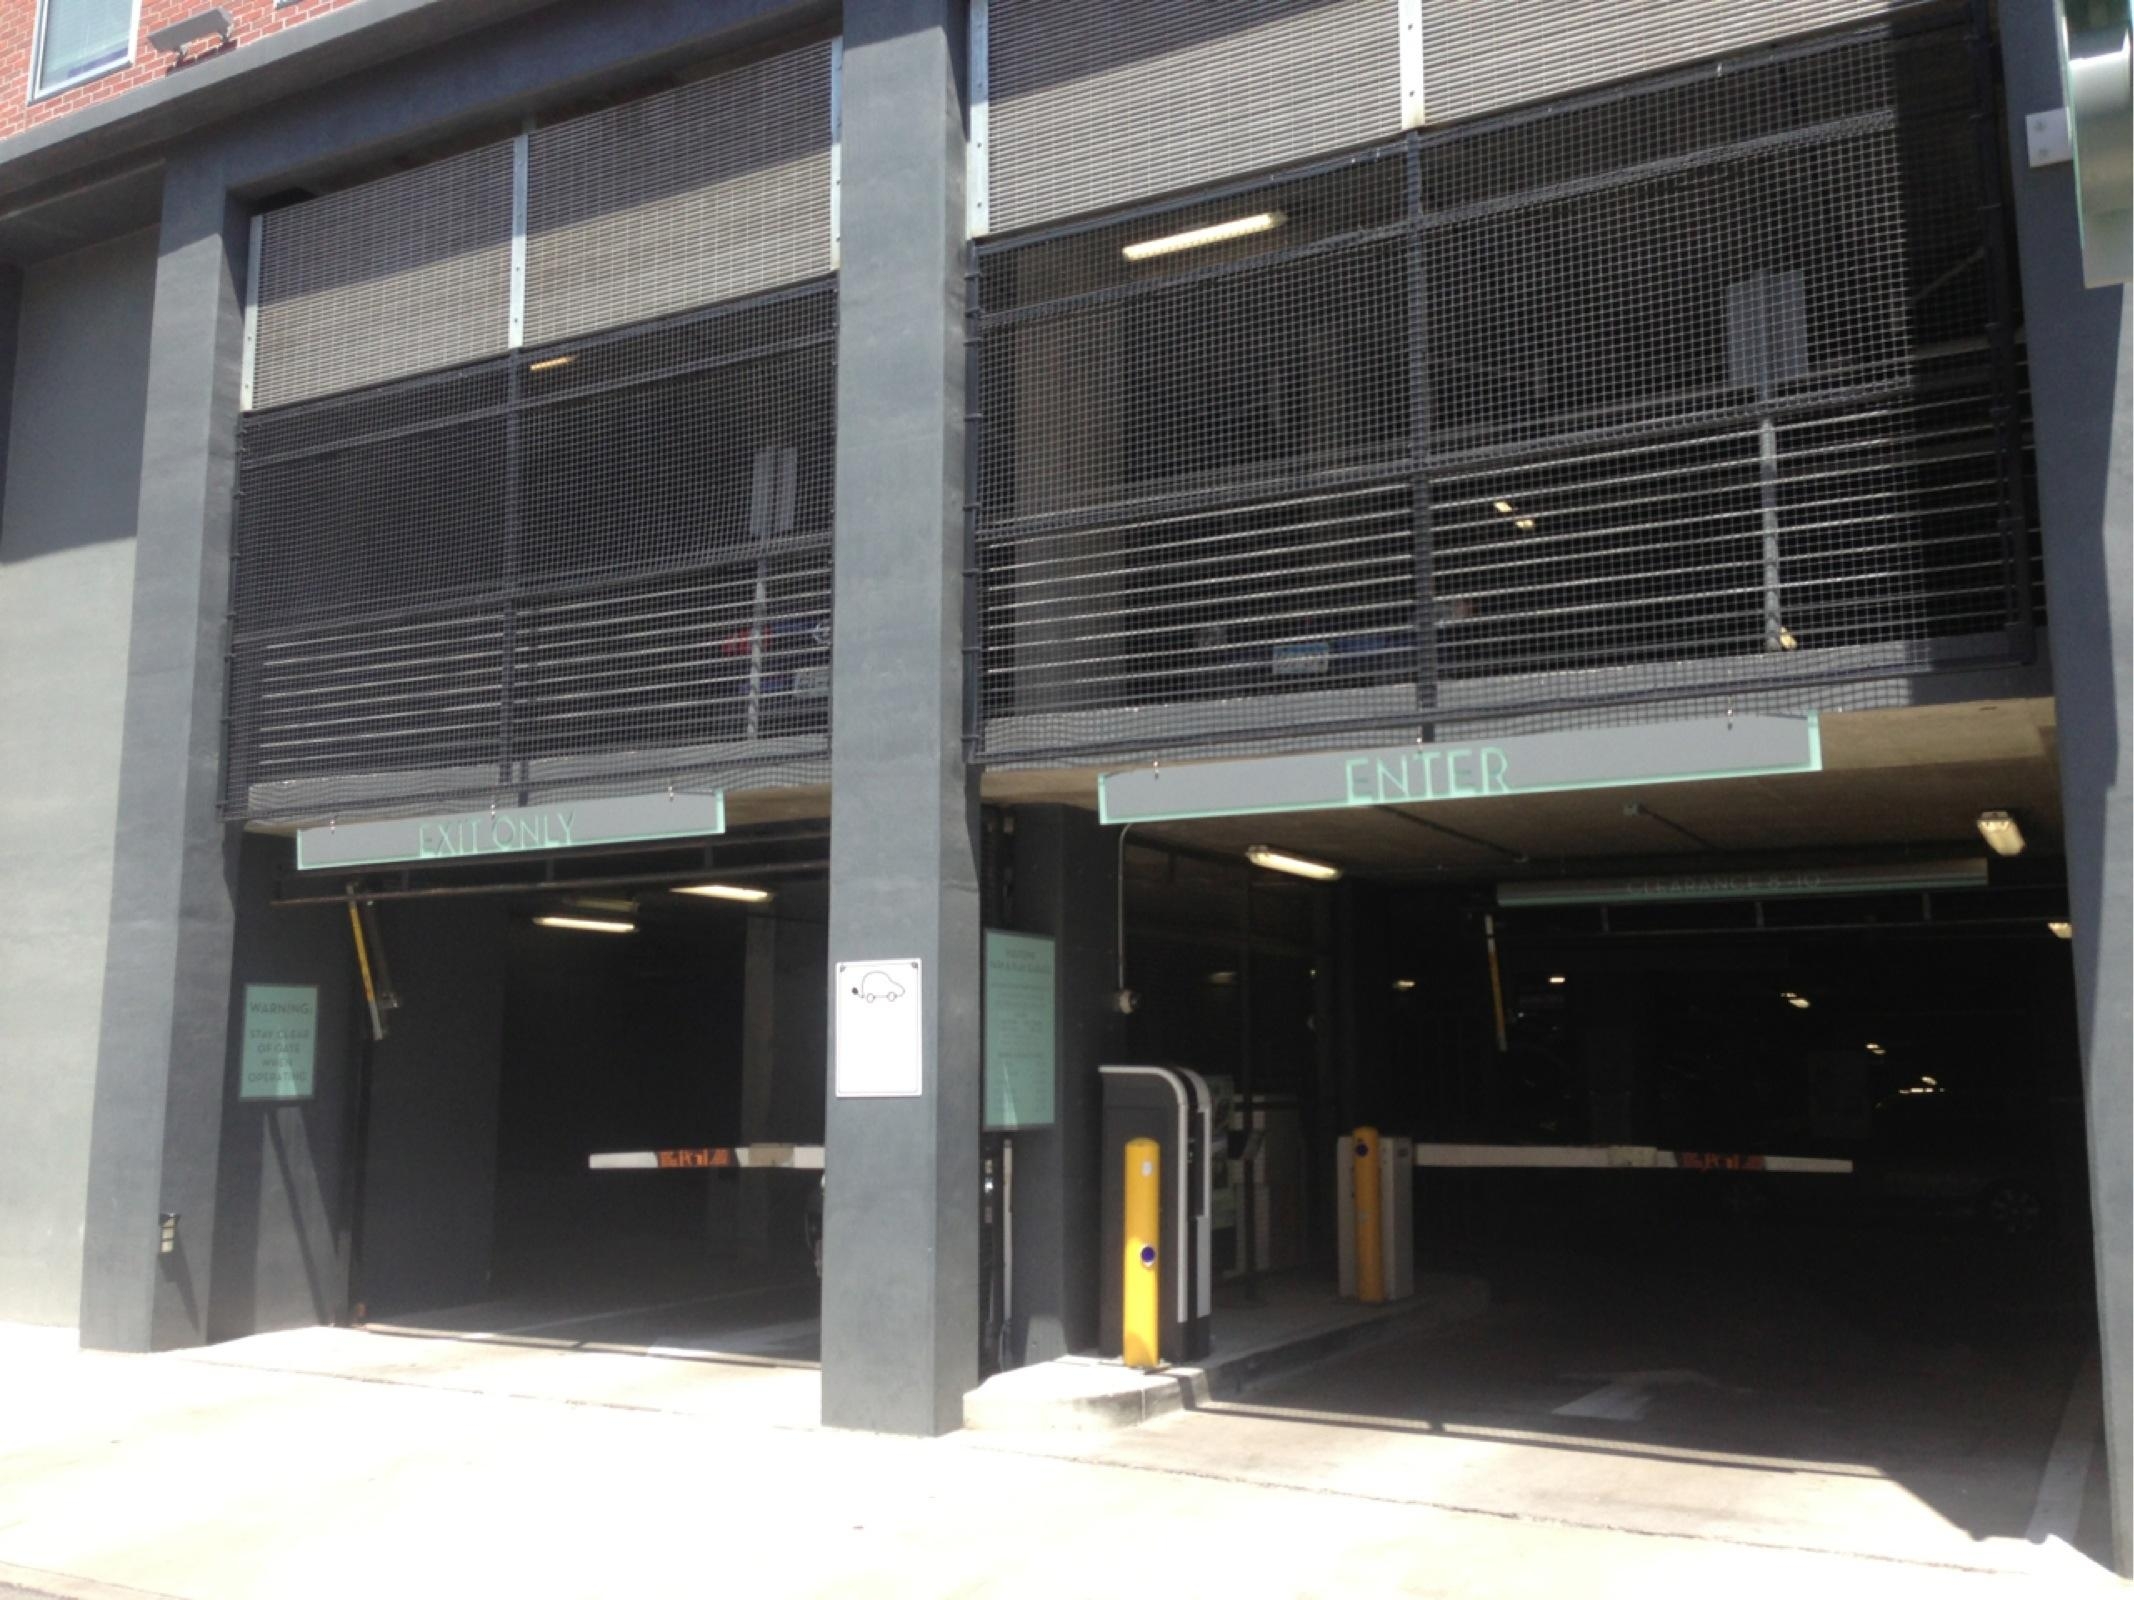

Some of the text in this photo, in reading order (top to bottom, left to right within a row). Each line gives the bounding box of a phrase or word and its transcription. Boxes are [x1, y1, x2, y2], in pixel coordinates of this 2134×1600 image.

[1345, 747, 1511, 806] ENTER
[418, 807, 576, 859] EXIT ONLY
[1626, 873, 1755, 894] CLEARANCE
[249, 1028, 310, 1040] STAY CLEAR
[257, 1042, 301, 1054] OF GATE
